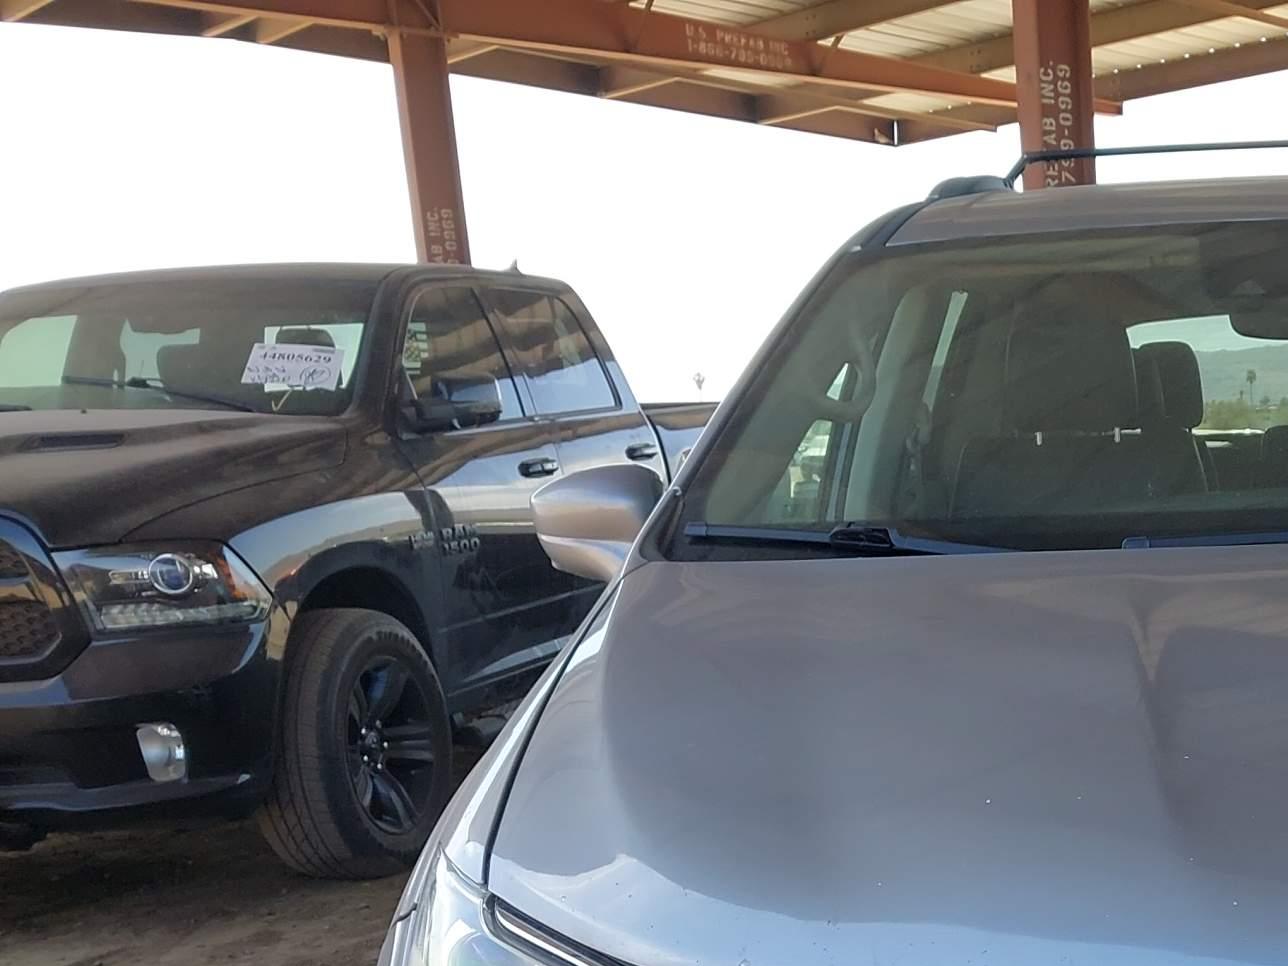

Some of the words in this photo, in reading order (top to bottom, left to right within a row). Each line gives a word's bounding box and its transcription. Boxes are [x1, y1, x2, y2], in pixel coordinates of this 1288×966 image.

[1040, 60, 1055, 105] INC.
[441, 524, 479, 541] RAM
[442, 537, 480, 556] 1500
